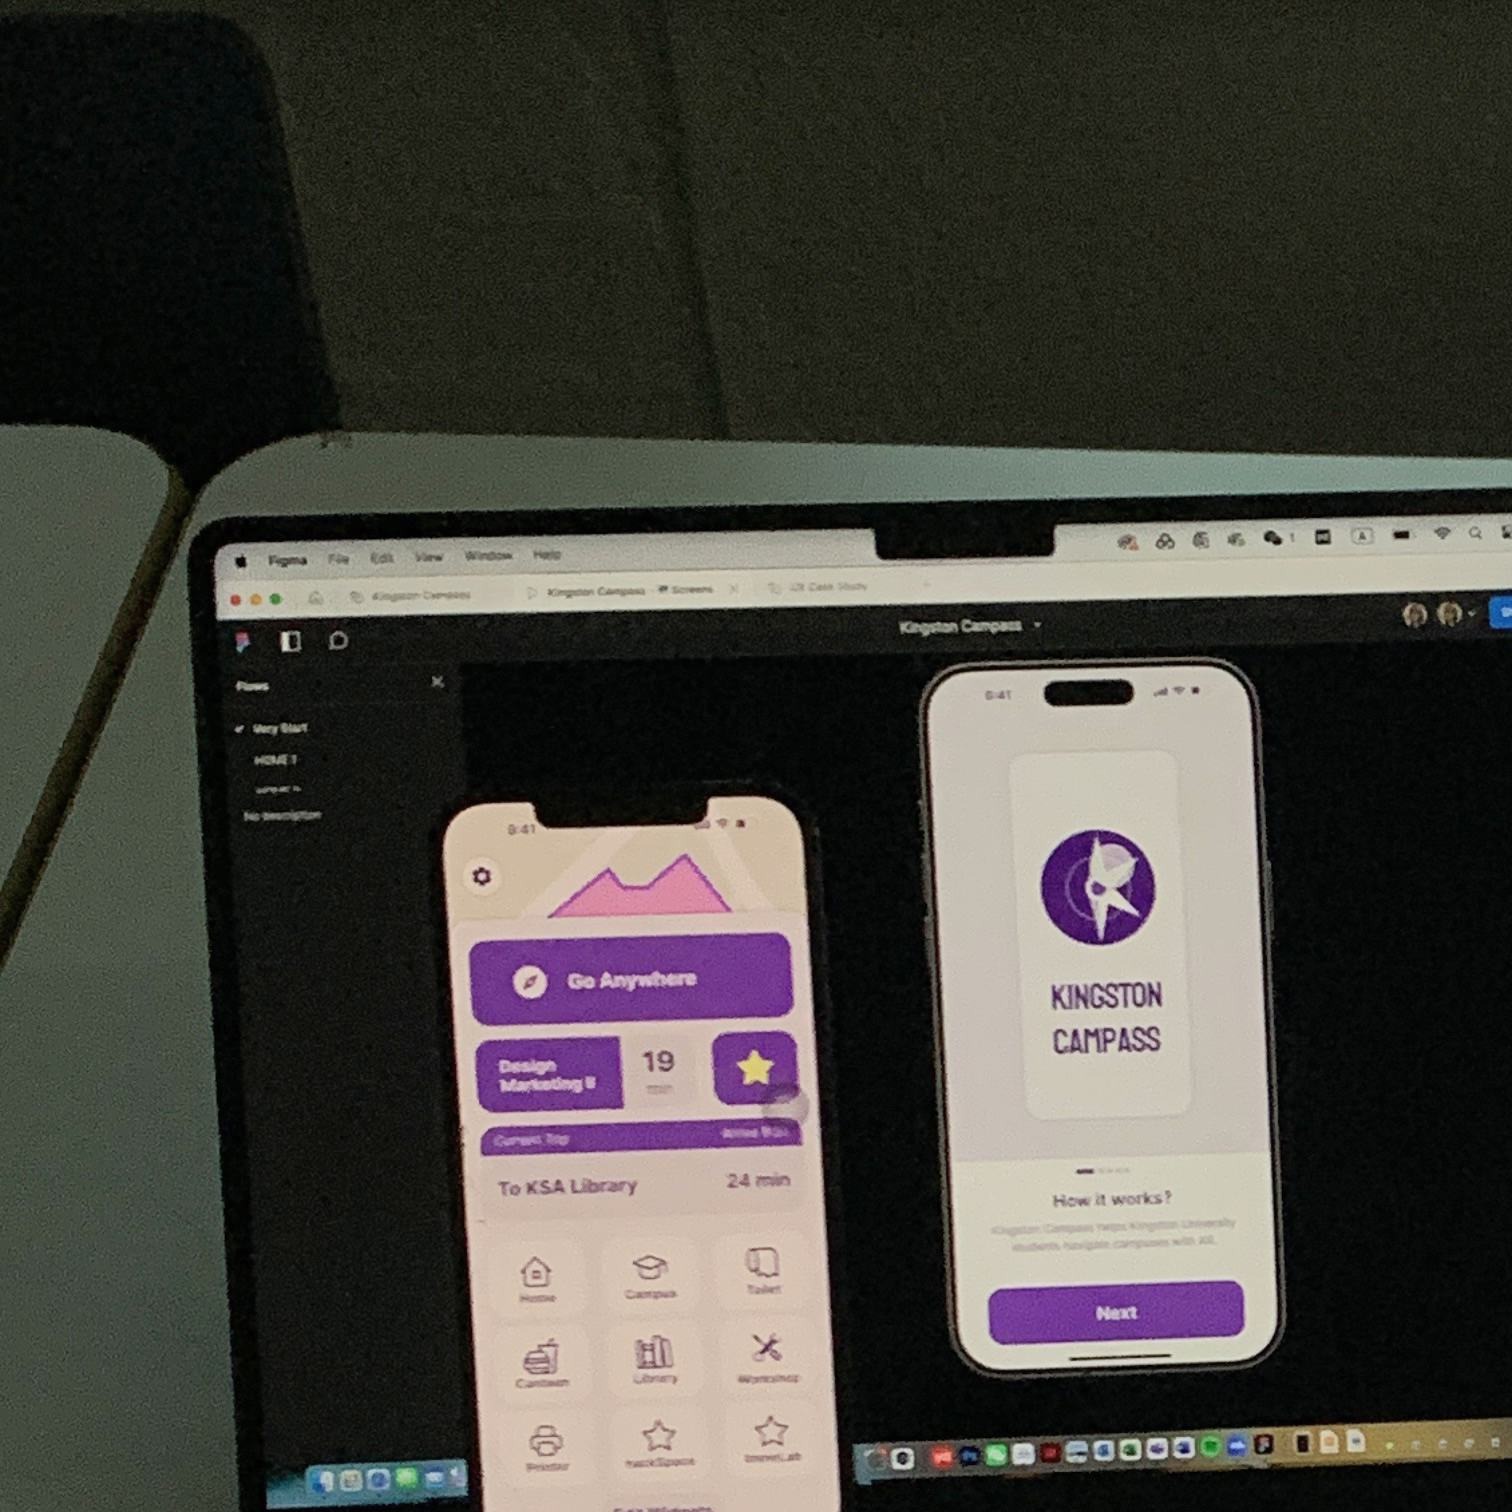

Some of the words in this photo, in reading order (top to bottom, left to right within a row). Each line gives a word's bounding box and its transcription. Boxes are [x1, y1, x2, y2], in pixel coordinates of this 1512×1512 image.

[268, 554, 308, 568] Figma
[900, 619, 959, 637] Kingston
[567, 971, 596, 990] Go
[602, 969, 698, 992] Anywhere
[1050, 980, 1164, 1011] KINGSTON
[1052, 1026, 1162, 1055] CAMPASS
[498, 1058, 558, 1076] Design
[641, 1049, 675, 1073] 19
[498, 1076, 584, 1094] Marketing
[498, 1179, 522, 1197] To
[525, 1178, 566, 1195] KSA
[570, 1176, 638, 1198] Library
[725, 1172, 750, 1189] 24
[755, 1173, 791, 1188] min
[1052, 1193, 1090, 1208] How
[1093, 1192, 1106, 1207] it
[1111, 1189, 1173, 1207] works?
[1095, 1305, 1139, 1321] Next
